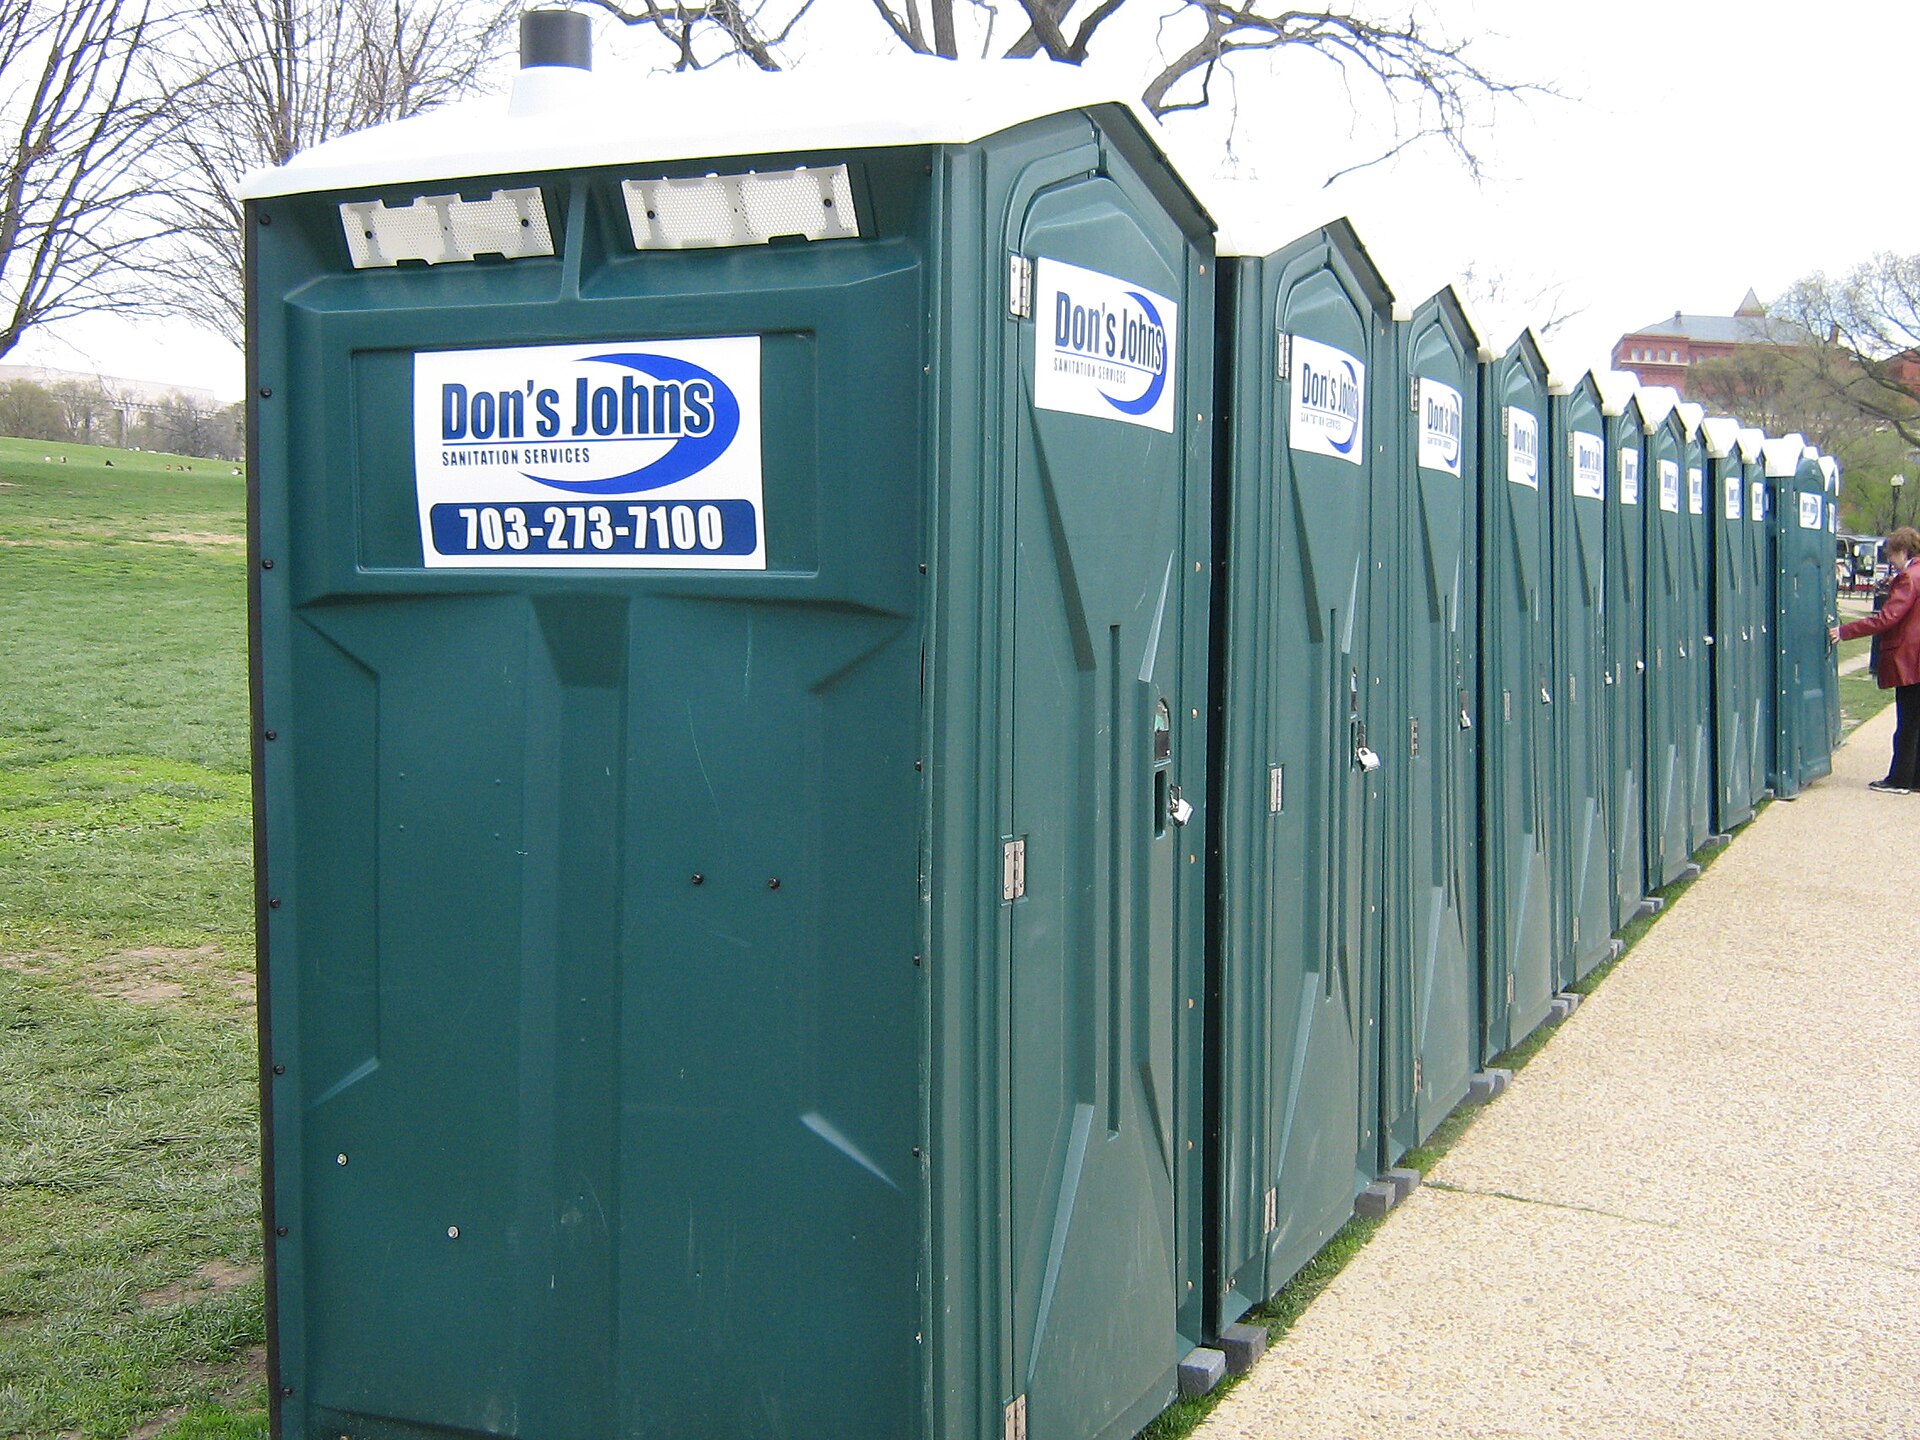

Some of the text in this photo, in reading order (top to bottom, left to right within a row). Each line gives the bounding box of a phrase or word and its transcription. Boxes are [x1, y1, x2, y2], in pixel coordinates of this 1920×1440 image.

[1055, 291, 1161, 371] Don's Johns
[442, 375, 711, 440] Don's Johns
[442, 448, 590, 466] SANITATION SERVICES
[459, 504, 724, 551] 703-273-7100
